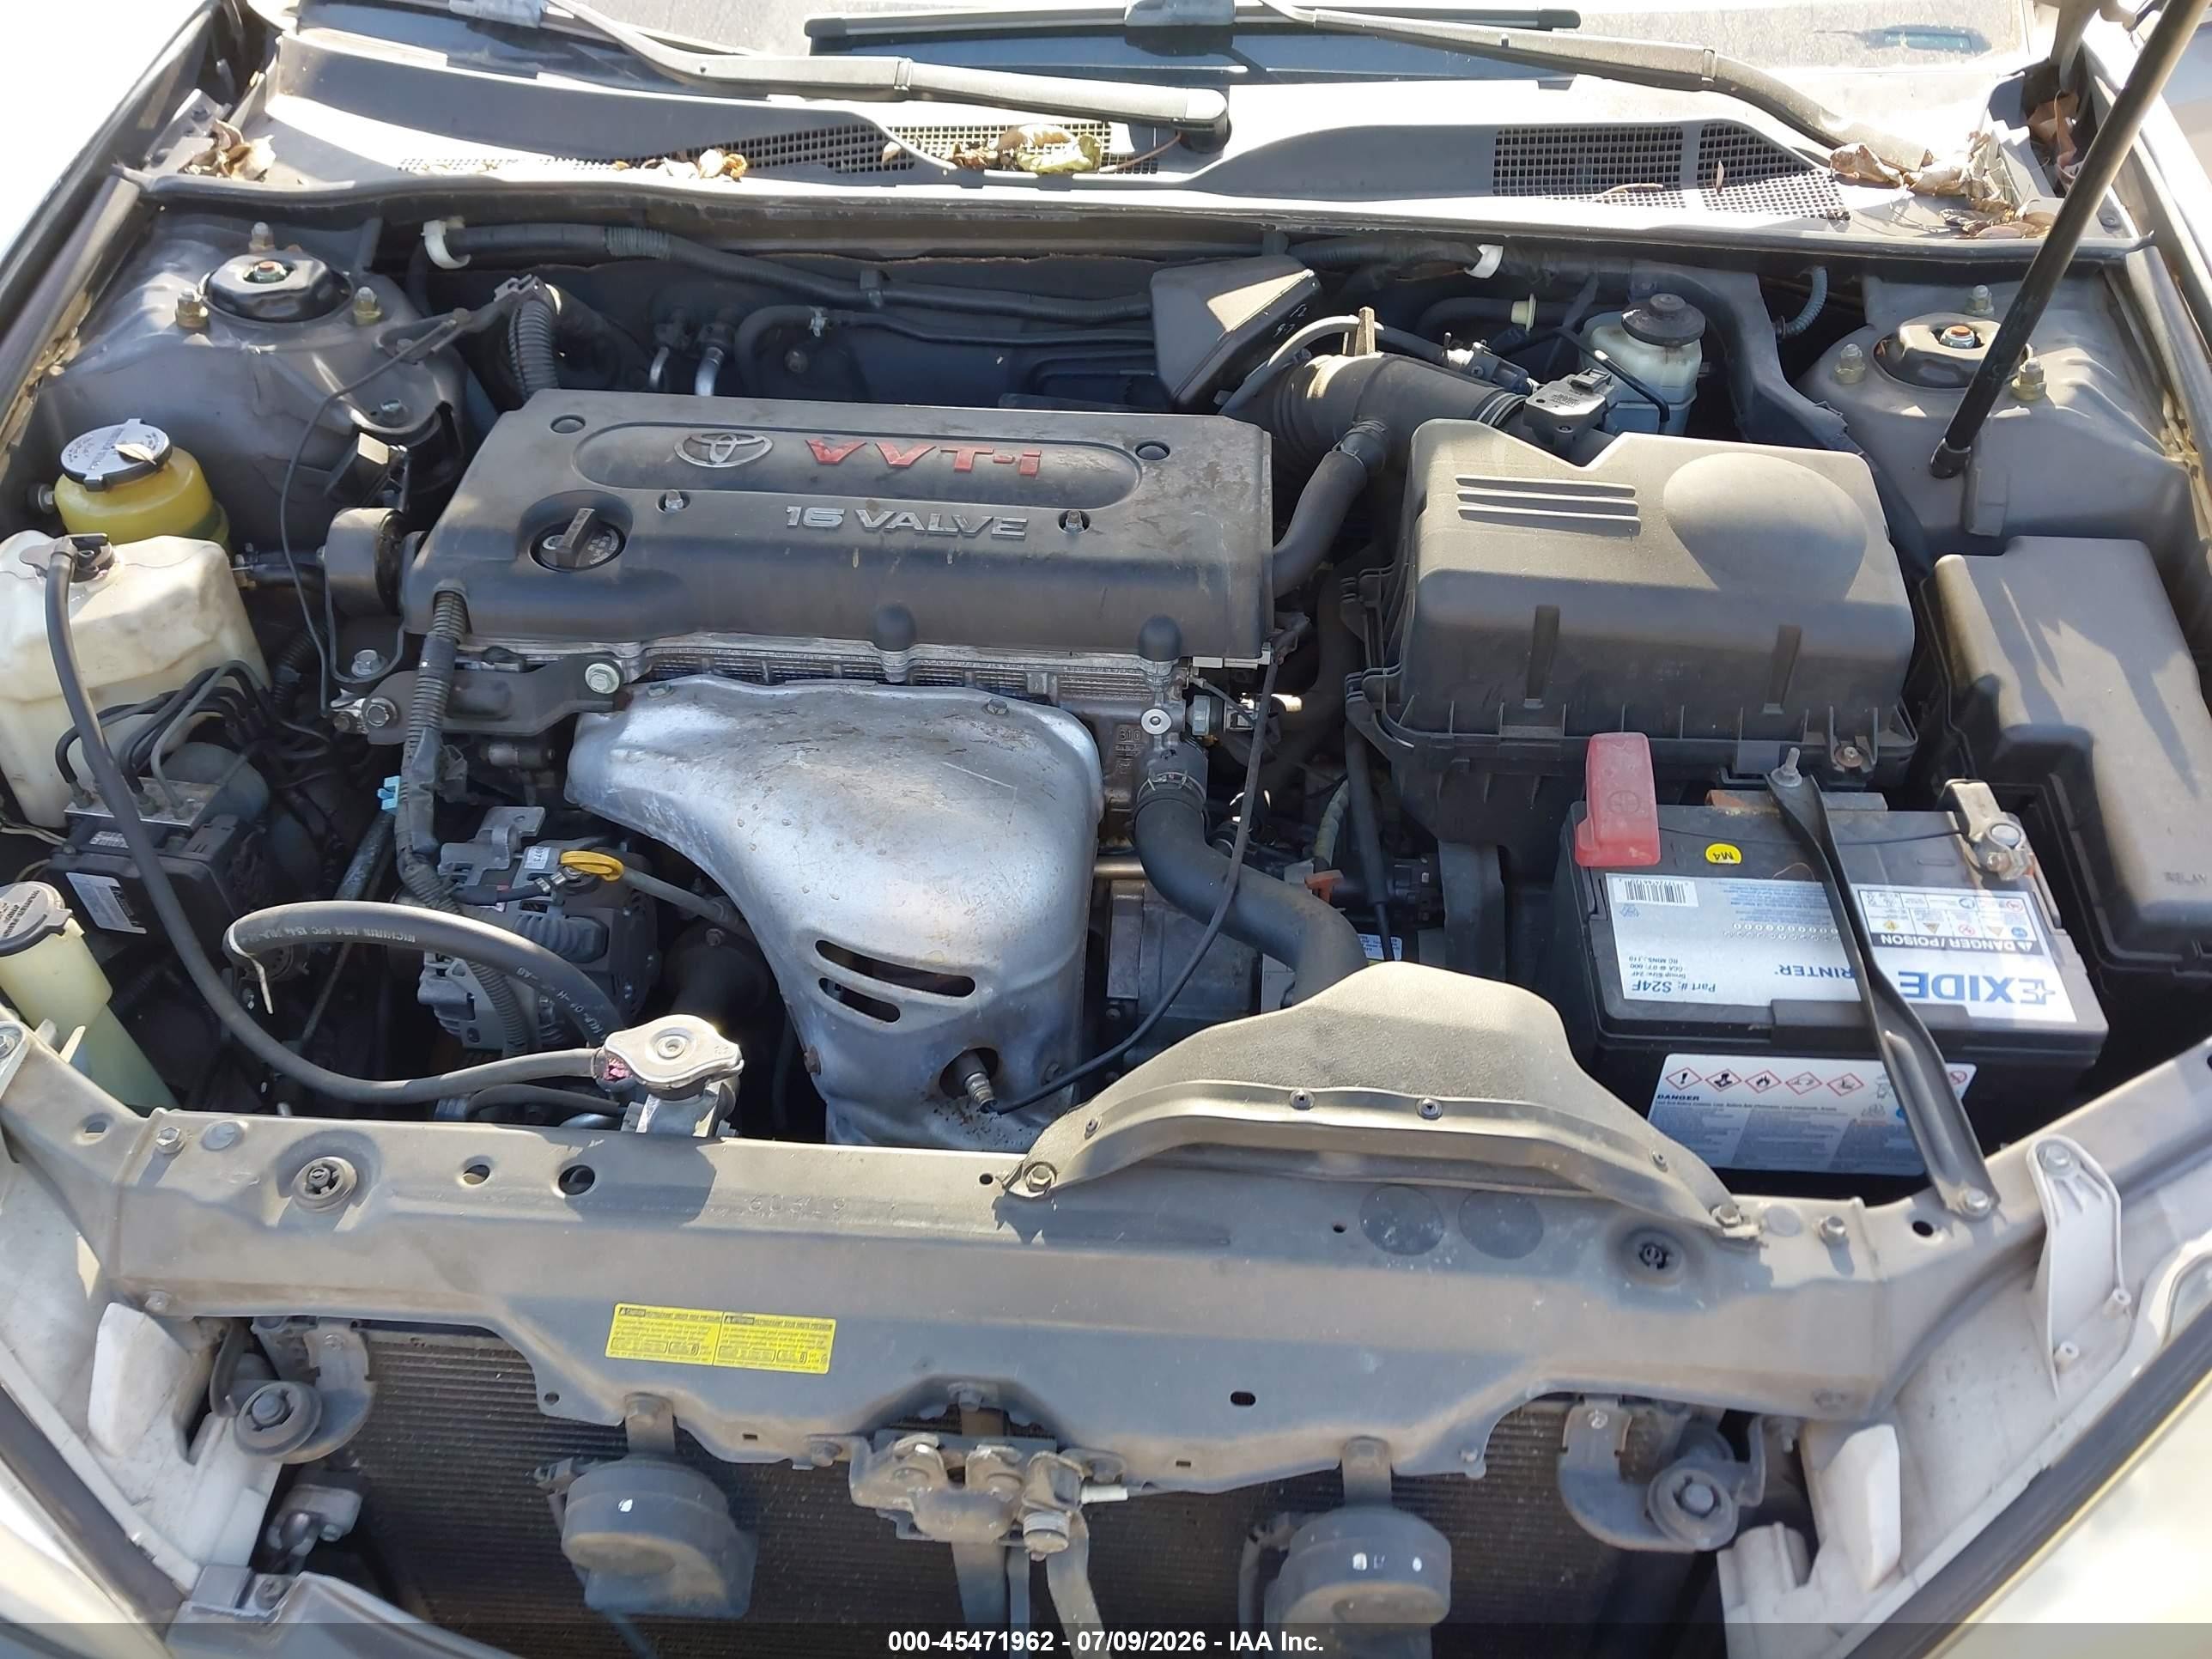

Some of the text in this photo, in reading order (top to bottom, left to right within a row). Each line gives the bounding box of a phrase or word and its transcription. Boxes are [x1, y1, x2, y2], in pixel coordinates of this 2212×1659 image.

[805, 438, 1042, 477] VVT-i
[785, 506, 1029, 539] 16 VALVE
[1881, 934, 1941, 947] POISON
[1949, 937, 2017, 951] DANGER
[1632, 979, 1673, 994] S24F
[1692, 982, 1716, 993] Part
[1897, 970, 2056, 1006] EXIDE
